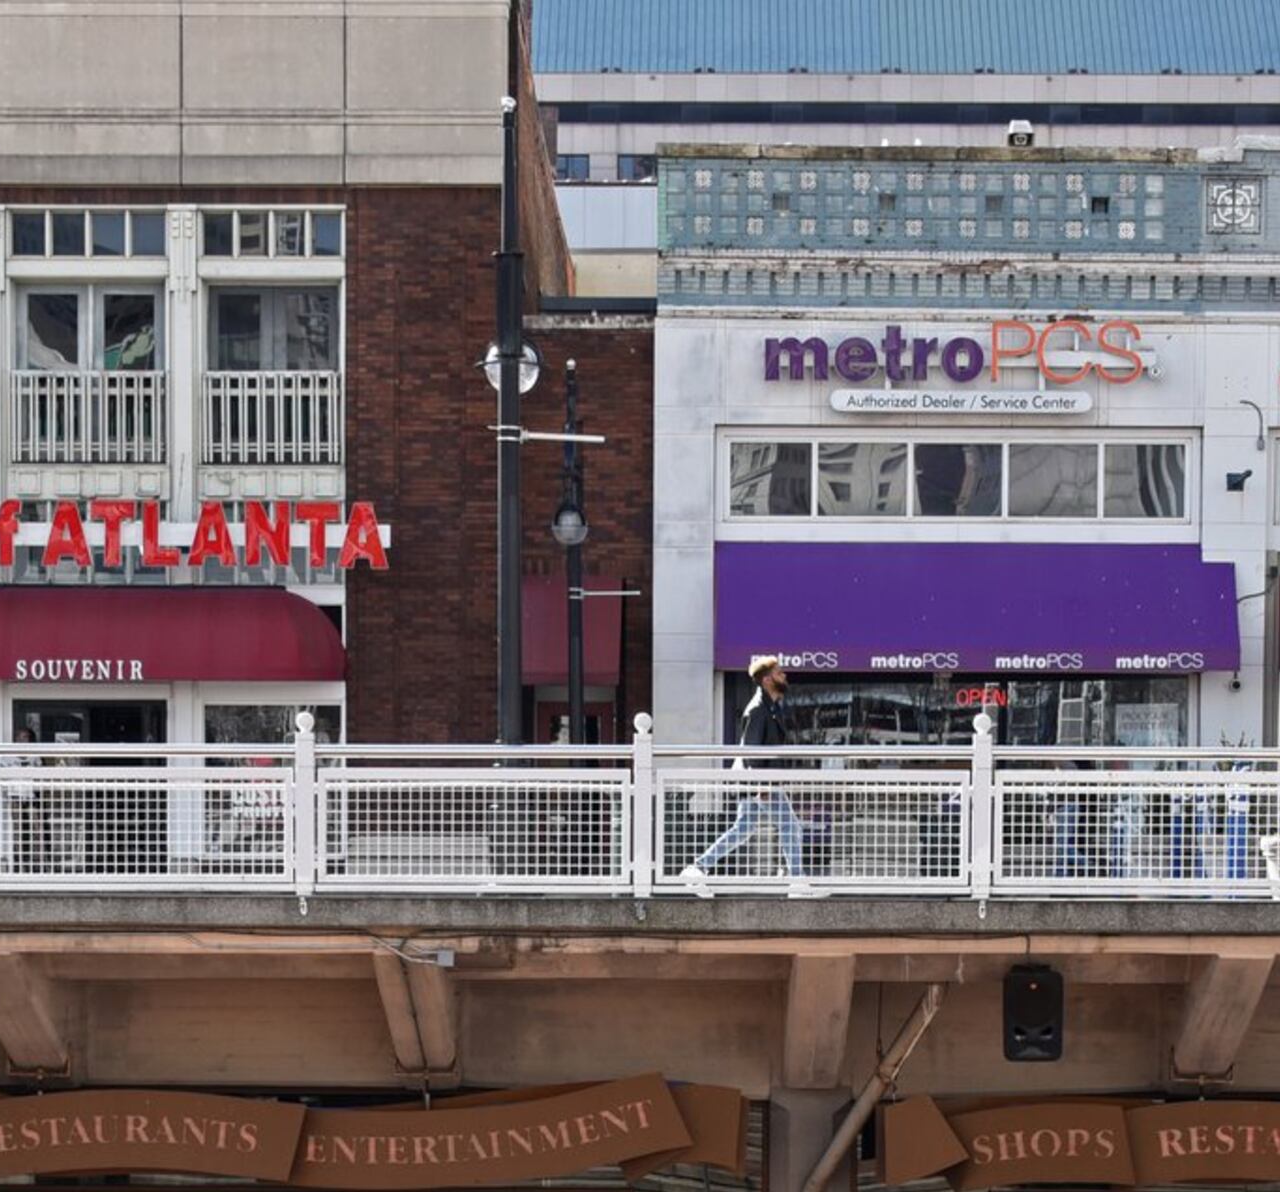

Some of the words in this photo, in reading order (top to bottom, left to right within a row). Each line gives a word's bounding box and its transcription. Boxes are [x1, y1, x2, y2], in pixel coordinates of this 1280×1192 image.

[763, 319, 1144, 385] metroPCS
[846, 395, 917, 409] Authorized
[922, 395, 966, 409] Dealer
[980, 395, 1028, 409] Service
[1032, 395, 1077, 410] Center
[41, 499, 391, 572] ATLANTA
[15, 658, 145, 682] SOUVENIR
[870, 652, 959, 669] metroPCS
[994, 652, 1084, 670] metroPCS
[1115, 651, 1205, 670] metroPCS
[955, 687, 1008, 708] OPEN
[304, 1099, 655, 1167] ENTERTAINMENT
[971, 1129, 1119, 1166] SHOPS
